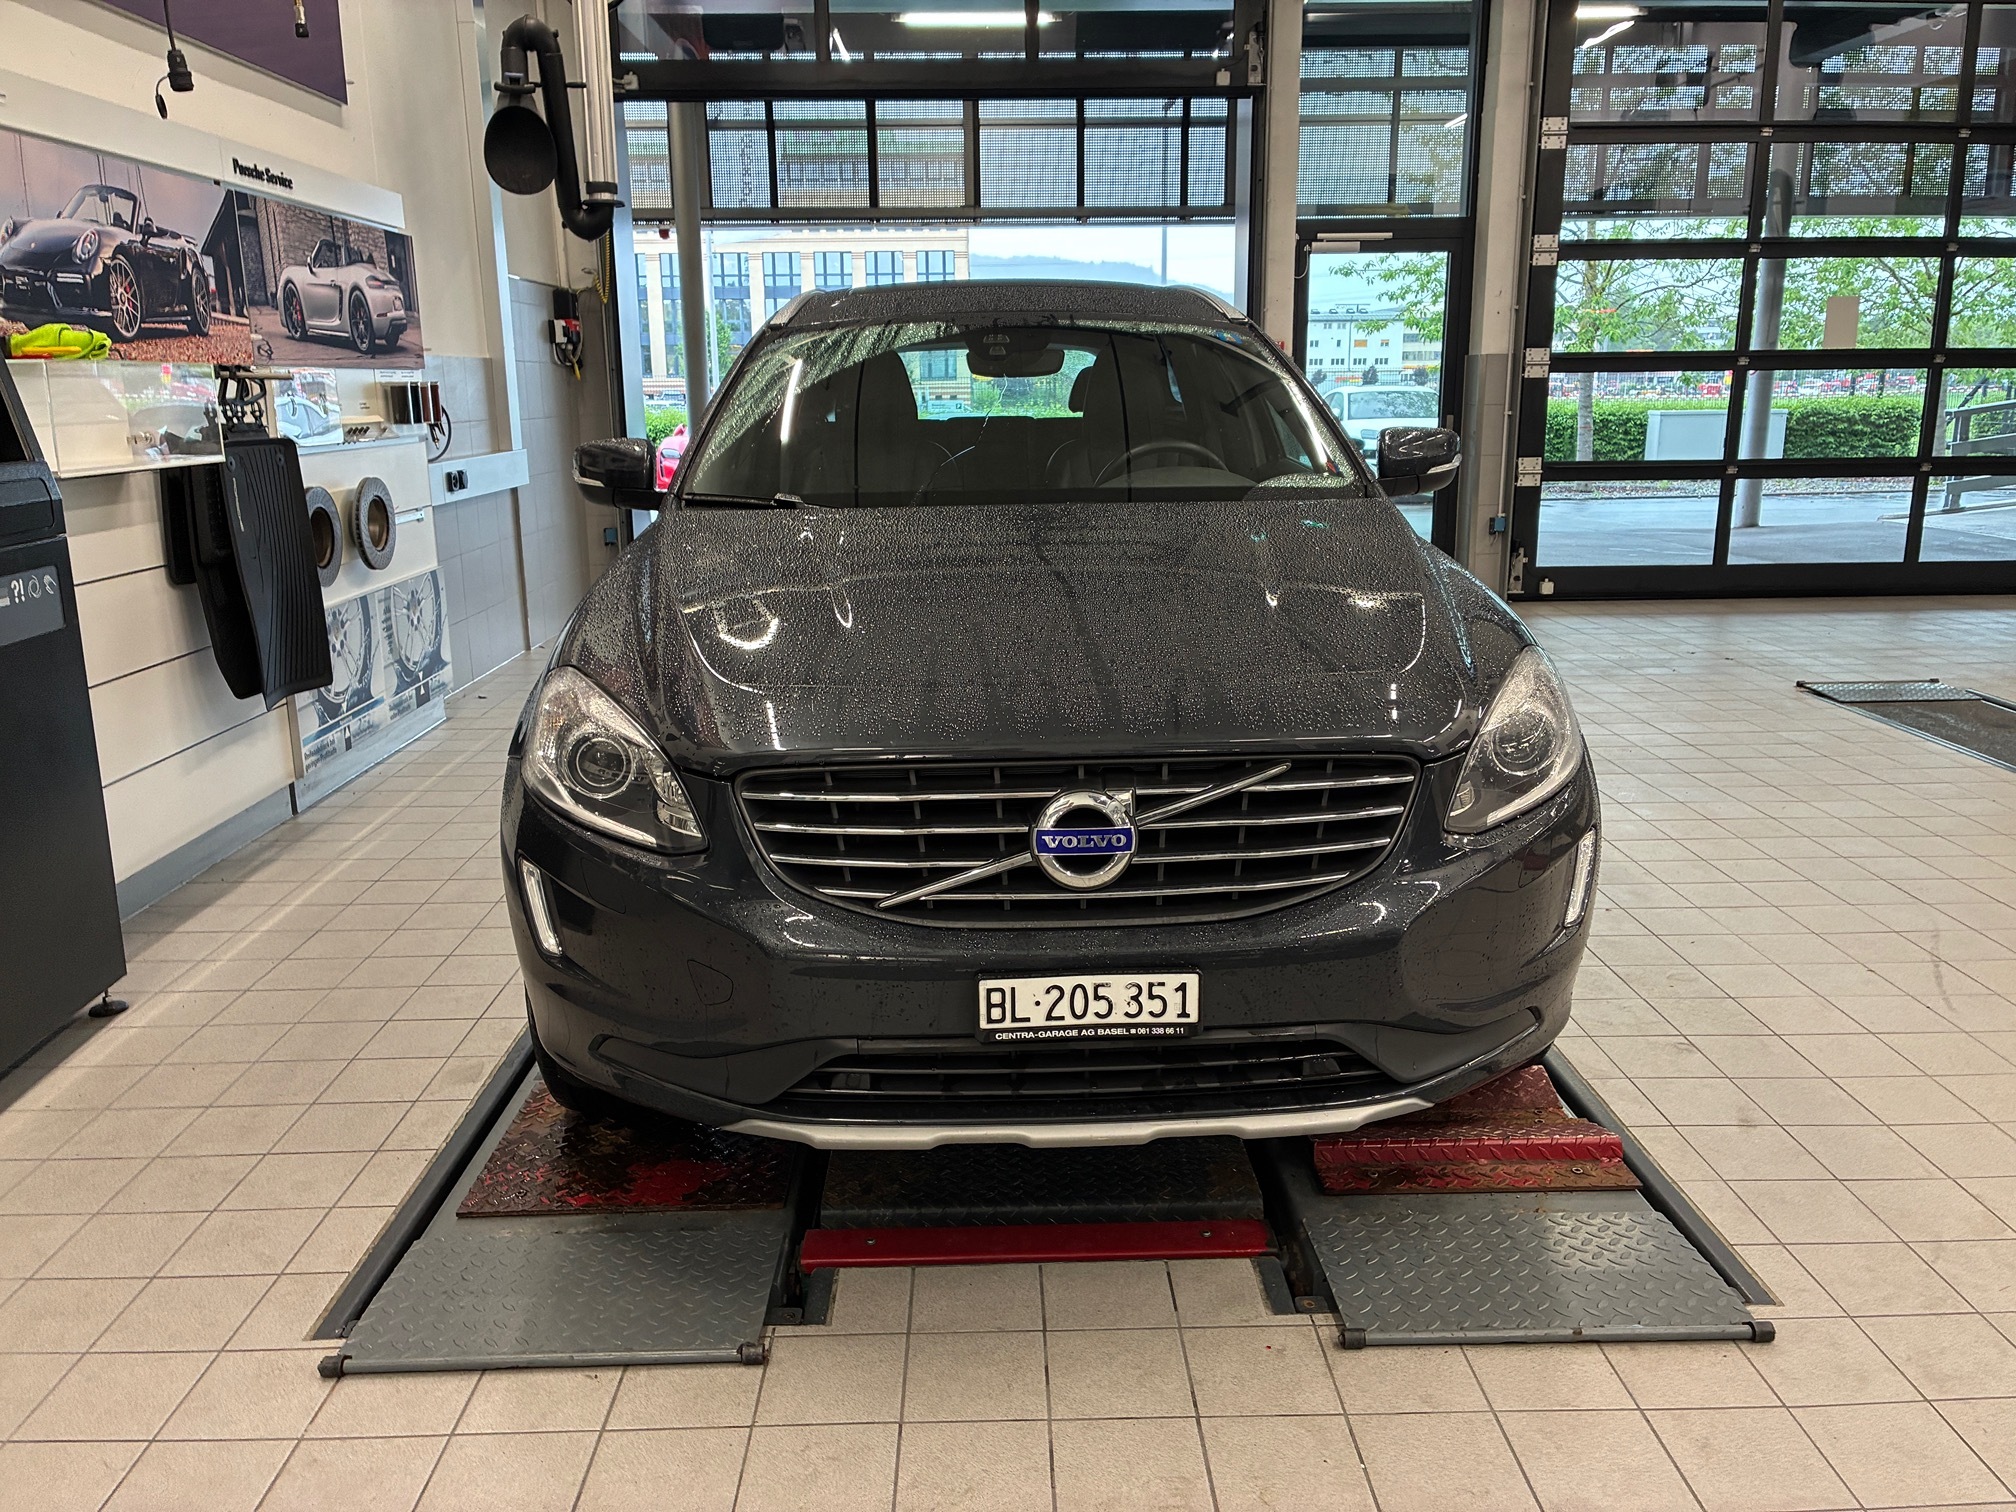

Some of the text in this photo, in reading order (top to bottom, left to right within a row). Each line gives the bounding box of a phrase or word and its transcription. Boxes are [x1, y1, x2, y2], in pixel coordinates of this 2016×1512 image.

[232, 157, 293, 189] Porsche Service
[1042, 834, 1127, 848] VOLVO
[1123, 981, 1191, 1019] 351
[995, 1029, 1079, 1040] CENTRA-GARAGE
[1081, 1028, 1095, 1036] AG
[1098, 1027, 1129, 1036] BASEL
[1137, 1027, 1150, 1035] 061
